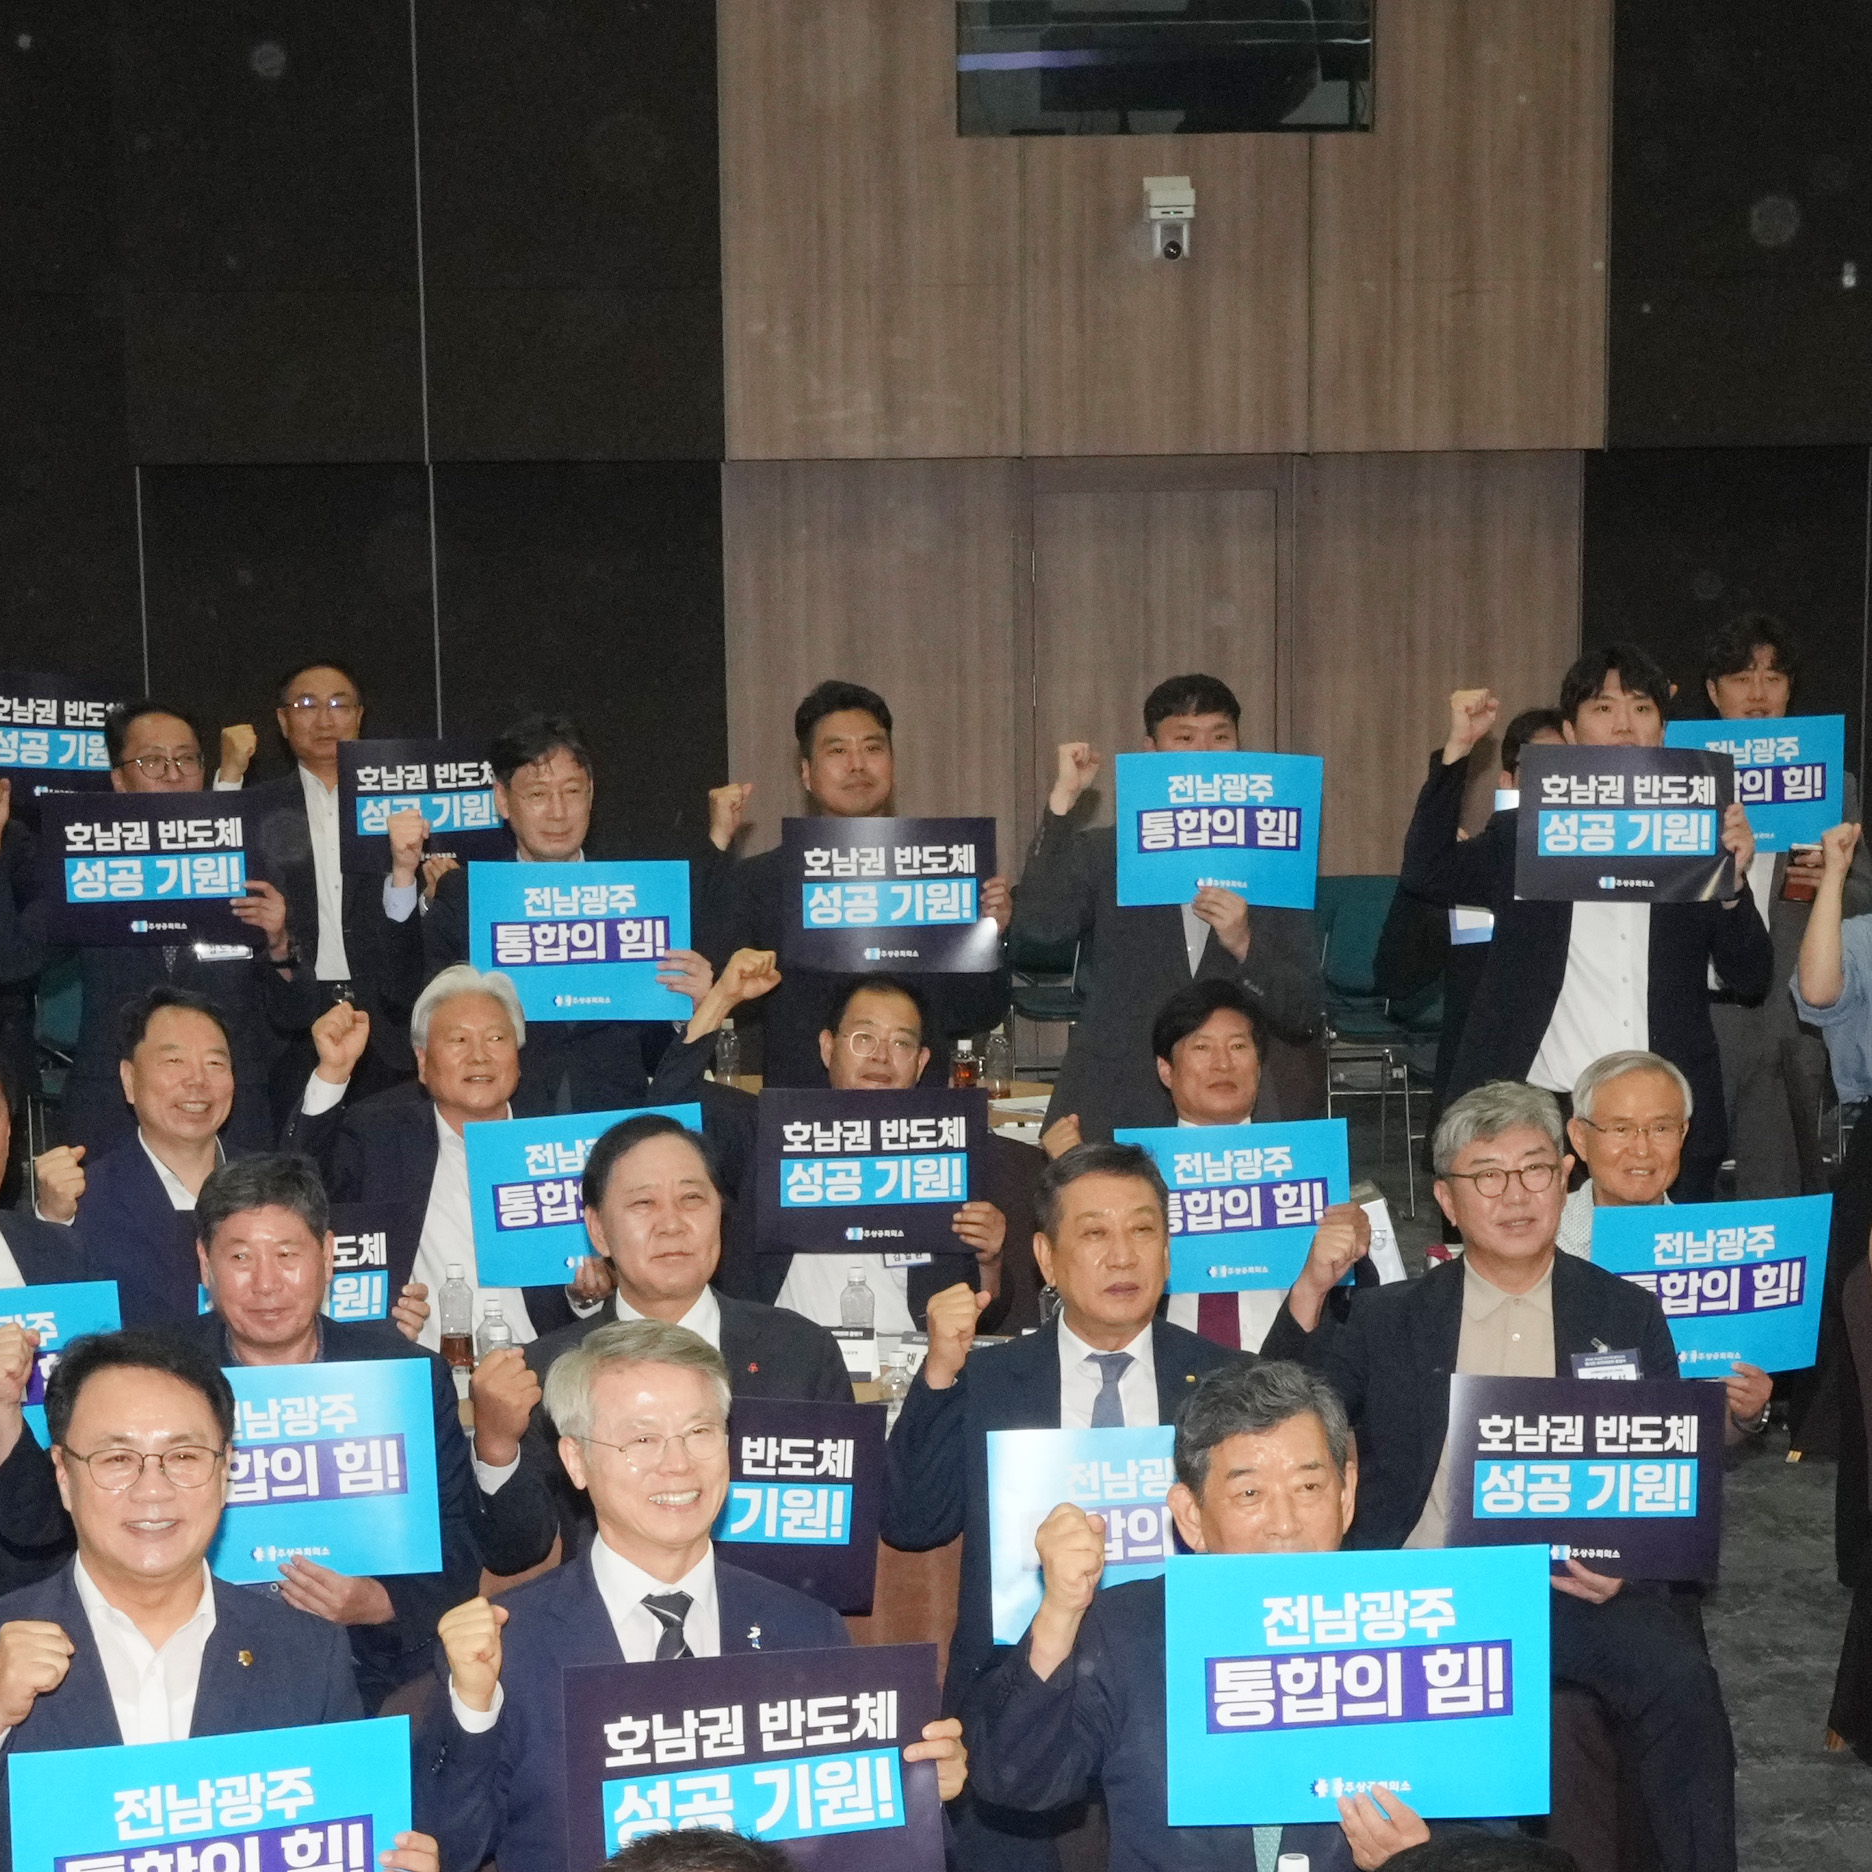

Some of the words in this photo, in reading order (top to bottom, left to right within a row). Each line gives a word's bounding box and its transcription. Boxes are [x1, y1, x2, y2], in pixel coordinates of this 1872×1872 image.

[356, 764, 428, 792] 호남권
[1168, 778, 1272, 804] 전남광주
[1541, 774, 1625, 805] 호남권
[1633, 774, 1716, 805] 반도체
[64, 821, 151, 852] 호남권
[157, 817, 243, 850] 반도체
[1141, 809, 1245, 850] 통합의
[1255, 809, 1297, 847] 힘!
[1544, 813, 1616, 852] 성공
[1629, 812, 1711, 852] 기원!
[71, 859, 144, 899] 성공
[155, 855, 241, 895] 기원!
[803, 846, 887, 877] 호남권
[894, 843, 976, 876] 반도체
[524, 885, 637, 917] 전남광주
[808, 884, 879, 924] 성공
[890, 882, 972, 921] 기원!
[495, 921, 606, 964] 통합의
[616, 919, 669, 959] 힘!
[782, 1119, 872, 1153] 호남권
[880, 1116, 966, 1151] 반도체
[786, 1160, 863, 1203] 성공
[875, 1157, 962, 1199] 기원!
[1179, 1150, 1293, 1185] 전남광주
[1272, 1182, 1324, 1225] 힘!
[1654, 1227, 1773, 1266] 전남광주
[1752, 1261, 1801, 1308] 힘!
[1477, 1415, 1584, 1453] 호남권
[1595, 1415, 1699, 1453] 반도체
[332, 1439, 400, 1494] 힘!
[741, 1438, 855, 1478] 반도체
[1481, 1464, 1572, 1513] 성공
[1586, 1463, 1691, 1512] 기원!
[733, 1488, 845, 1539] 기원!
[1263, 1588, 1456, 1647] 전남광주
[1213, 1652, 1403, 1727] 통합의
[1422, 1646, 1504, 1715] 힘!
[603, 1704, 746, 1768] 호남권
[758, 1690, 898, 1752] 반도체
[114, 1767, 314, 1841] 전남광주
[754, 1756, 894, 1833] 기원!
